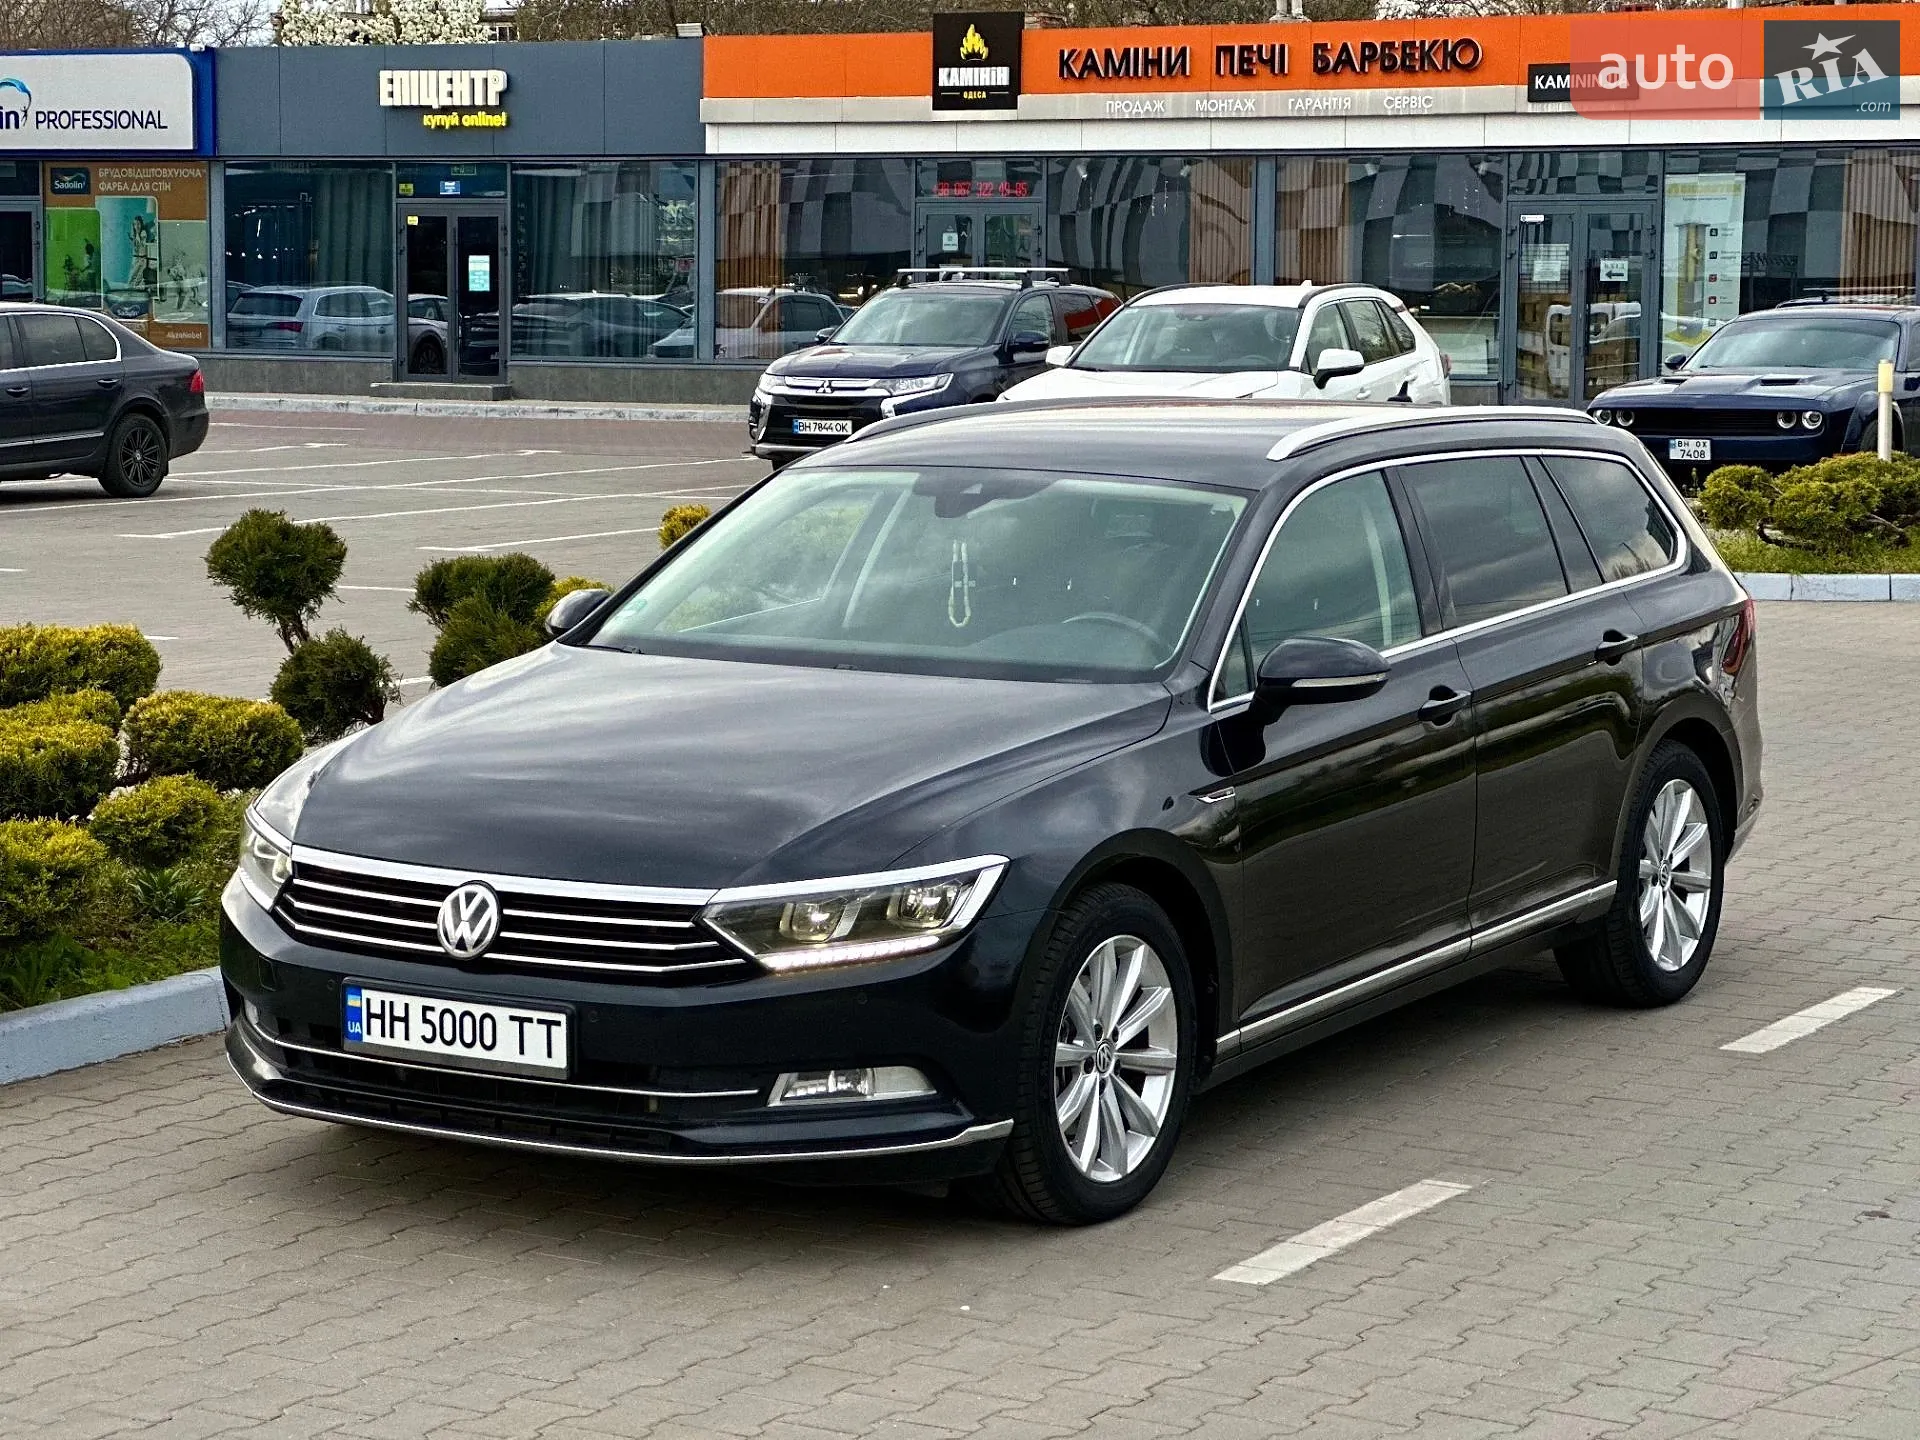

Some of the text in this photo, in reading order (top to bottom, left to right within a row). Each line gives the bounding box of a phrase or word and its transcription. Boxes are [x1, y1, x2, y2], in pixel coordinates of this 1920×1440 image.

[1057, 37, 1482, 80] КАМІНИ ПЕЧІ БАРБЕКЮ
[379, 69, 508, 109] ЕПІЦЕНТР
[963, 91, 987, 99] ОДЕСА
[1105, 95, 1433, 114] ПРОДАЖ МОНТАЖ ГАРАНТІЯ СЕРВІС
[35, 109, 168, 130] PROFESSIONAL
[423, 111, 507, 129] купуй online!
[54, 179, 84, 190] Sadolin
[98, 181, 129, 191] ФАРБА
[130, 182, 150, 192] ДЛЯ
[798, 421, 849, 433] BH 7844 OK
[1680, 449, 1705, 458] 7408
[347, 1020, 362, 1034] UA
[366, 997, 562, 1059] HH 5000 TT
